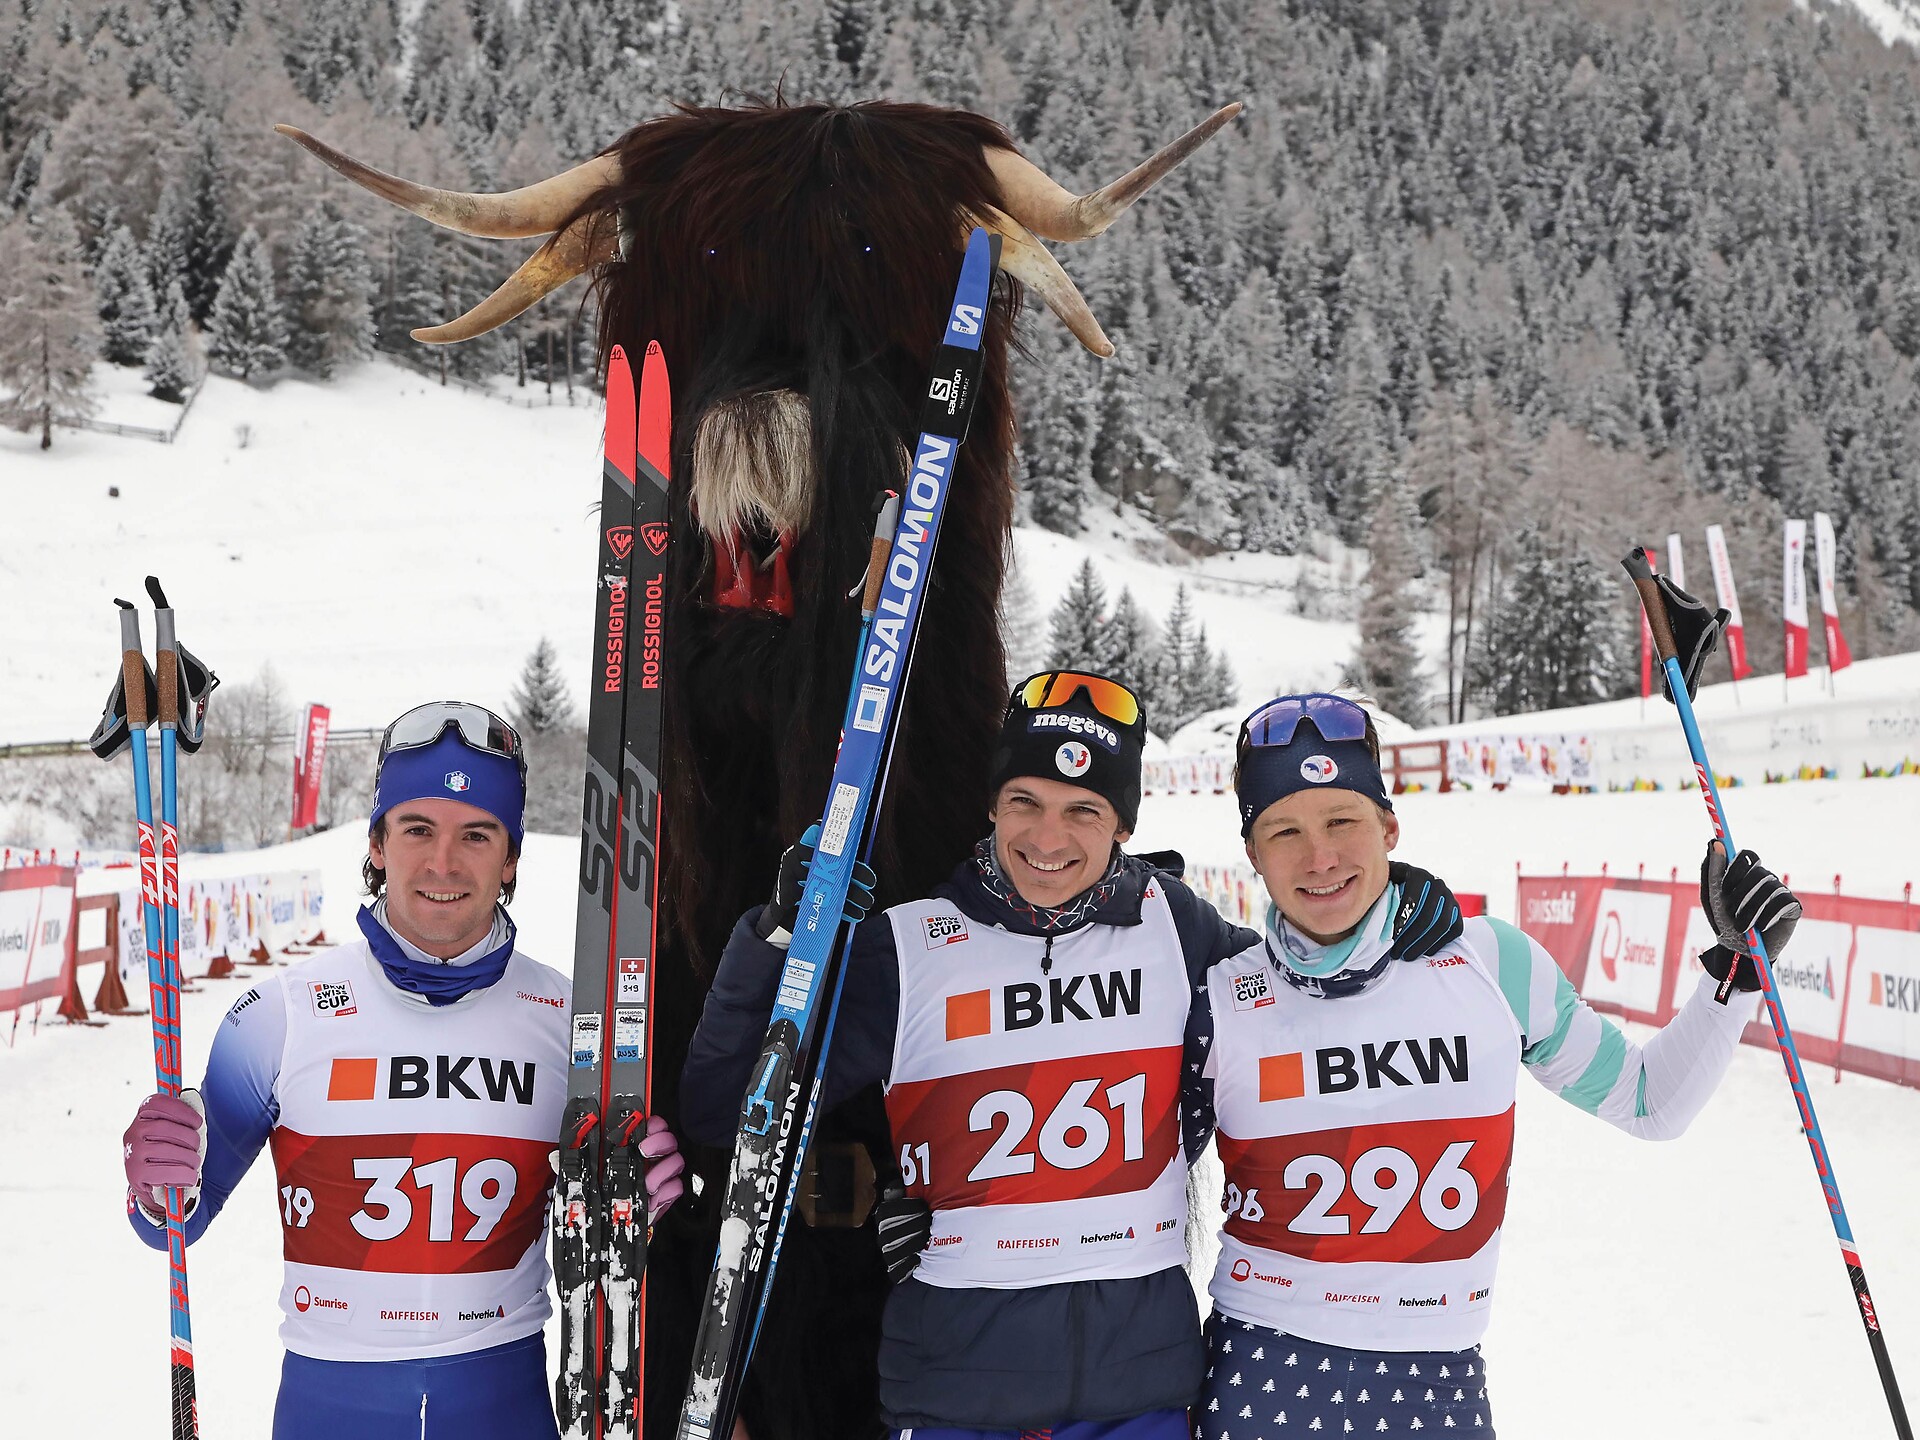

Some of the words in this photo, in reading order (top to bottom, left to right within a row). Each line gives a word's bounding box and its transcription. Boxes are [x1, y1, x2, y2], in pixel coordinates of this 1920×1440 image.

[948, 369, 963, 415] salomon
[865, 434, 951, 682] SALOMON
[642, 573, 664, 690] ROSSIGNOL
[1033, 713, 1118, 746] megève
[138, 820, 160, 907] KV+
[162, 821, 178, 907] KV+
[928, 919, 960, 930] SWISS
[929, 924, 961, 939] CUP
[623, 974, 637, 982] ITA
[1235, 978, 1266, 990] SWISS
[1777, 961, 1822, 991] helvetia
[316, 989, 347, 1000] SWISS
[317, 996, 349, 1010] CUP
[516, 990, 565, 1008] swissski
[1003, 968, 1142, 1032] BKW
[1236, 985, 1267, 1002] CUP
[388, 1055, 536, 1105] BKW
[761, 1055, 778, 1087] SALOMON
[1315, 1035, 1469, 1095] BKW
[967, 1073, 1146, 1183] 261
[749, 1081, 800, 1272] SALOMON
[900, 1141, 931, 1187] 61
[350, 1157, 518, 1242] 319
[1221, 1182, 1265, 1222] 96
[1283, 1140, 1479, 1235] 296
[281, 1184, 315, 1228] 19
[934, 1234, 963, 1246] Sunrise
[1080, 1230, 1124, 1244] helvetia
[1162, 1218, 1177, 1231] BKW
[997, 1237, 1060, 1250] RAIFFEISEN
[1253, 1272, 1293, 1288] Sunrise
[313, 1295, 348, 1310] Sunrise
[380, 1310, 439, 1321] RAIFFEISEN
[458, 1310, 495, 1321] helvetia
[1399, 1296, 1437, 1308] helvetia
[1859, 1292, 1879, 1331] KV+
